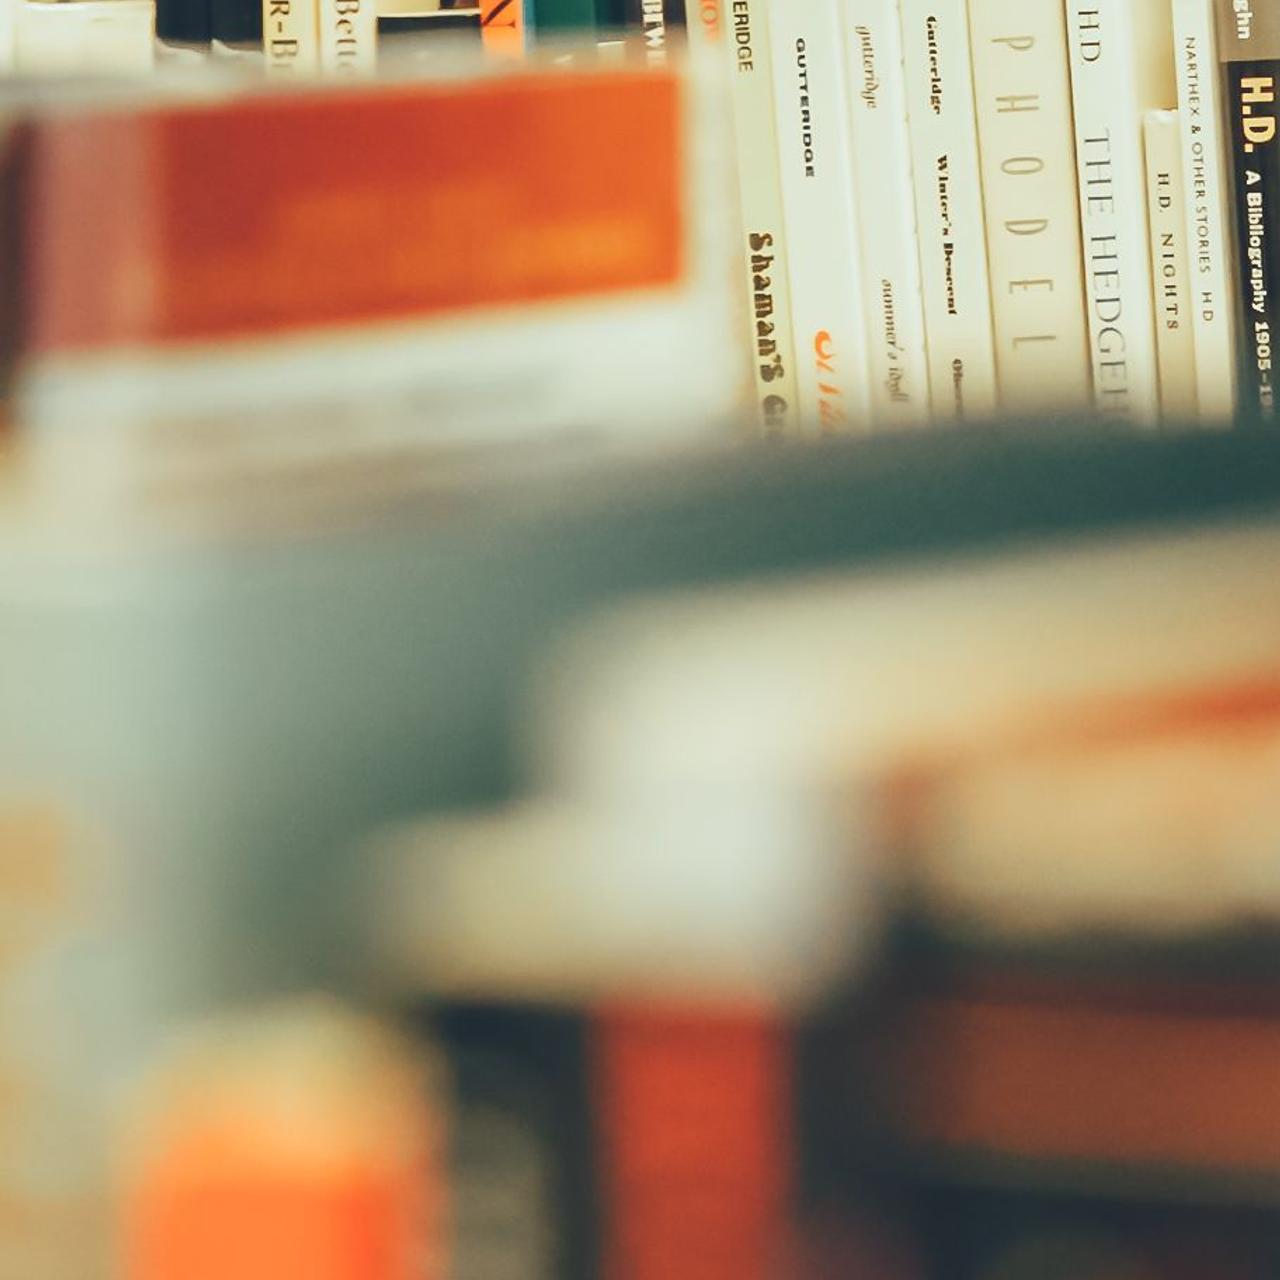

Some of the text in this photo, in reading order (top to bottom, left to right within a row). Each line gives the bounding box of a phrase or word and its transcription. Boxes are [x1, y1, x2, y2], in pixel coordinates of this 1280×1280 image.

[795, 37, 815, 177] GUTTERIDGE
[1185, 36, 1200, 117] NARTHEX
[926, 15, 942, 115] Gutteridge
[936, 155, 953, 236] Winter's
[1190, 124, 1201, 135] &
[1084, 127, 1114, 216] THE
[1191, 142, 1206, 199] OTHER
[1161, 233, 1179, 330] NIGHTS
[1195, 206, 1212, 274] STORIES
[1240, 77, 1276, 412] H.D. A Bibliography 1905-19
